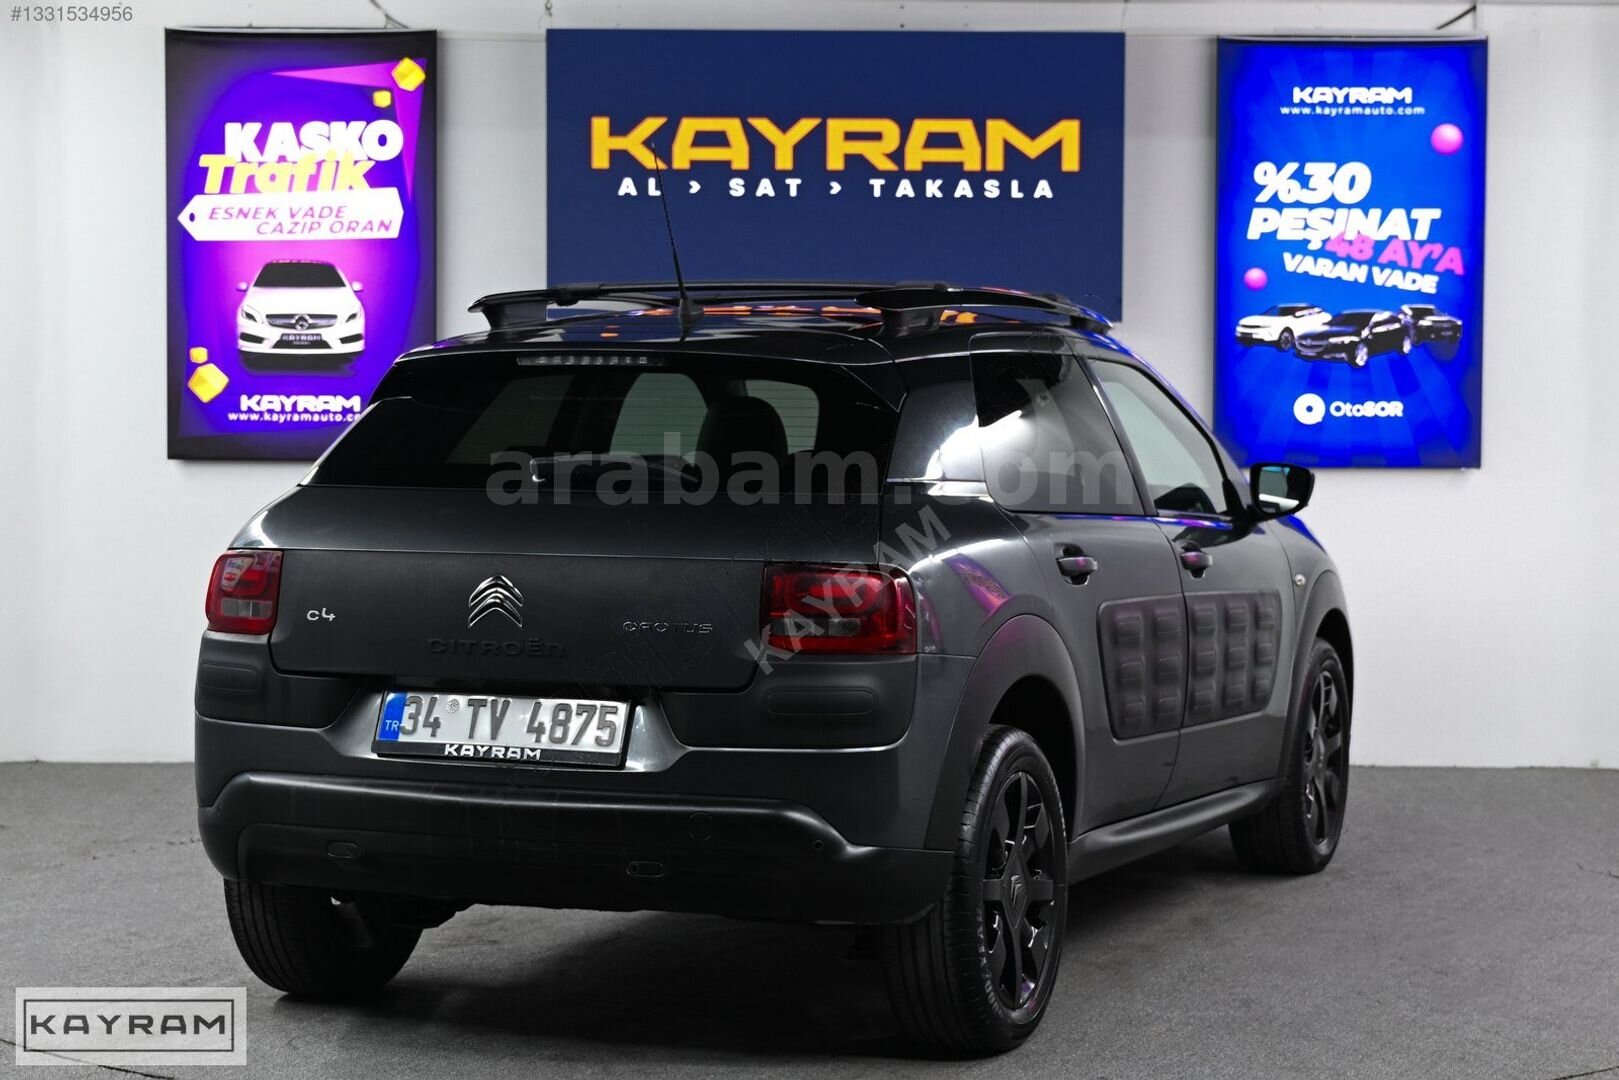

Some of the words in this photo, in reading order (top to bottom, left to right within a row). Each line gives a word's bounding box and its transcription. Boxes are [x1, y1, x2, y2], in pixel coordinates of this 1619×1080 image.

[1292, 86, 1413, 104] KAYRAM
[1280, 105, 1425, 117] www.kayramauto.com
[224, 119, 404, 162] KASKO
[590, 116, 1081, 172] KAYRAM
[199, 150, 376, 195] Trafik
[618, 177, 661, 196] AL
[729, 178, 802, 197] SAT
[869, 178, 1054, 199] TAKASLA
[1253, 161, 1372, 204] %30
[208, 206, 279, 220] ESNEK
[289, 205, 348, 219] VADE
[256, 221, 322, 235] CAZIP
[329, 219, 392, 234] ORAN
[1324, 231, 1376, 261] 48
[1283, 252, 1368, 283] VARAN
[1372, 265, 1439, 294] VADE
[240, 394, 361, 412] KAYRAM
[1329, 400, 1404, 417] OtoSOR
[228, 411, 361, 423] www.kayramauto.co
[623, 620, 713, 634] CACTUS
[385, 719, 400, 732] TR
[400, 695, 441, 738] 34
[467, 698, 511, 741] TV
[525, 701, 618, 748] 4875
[443, 743, 542, 762] KAYRAM
